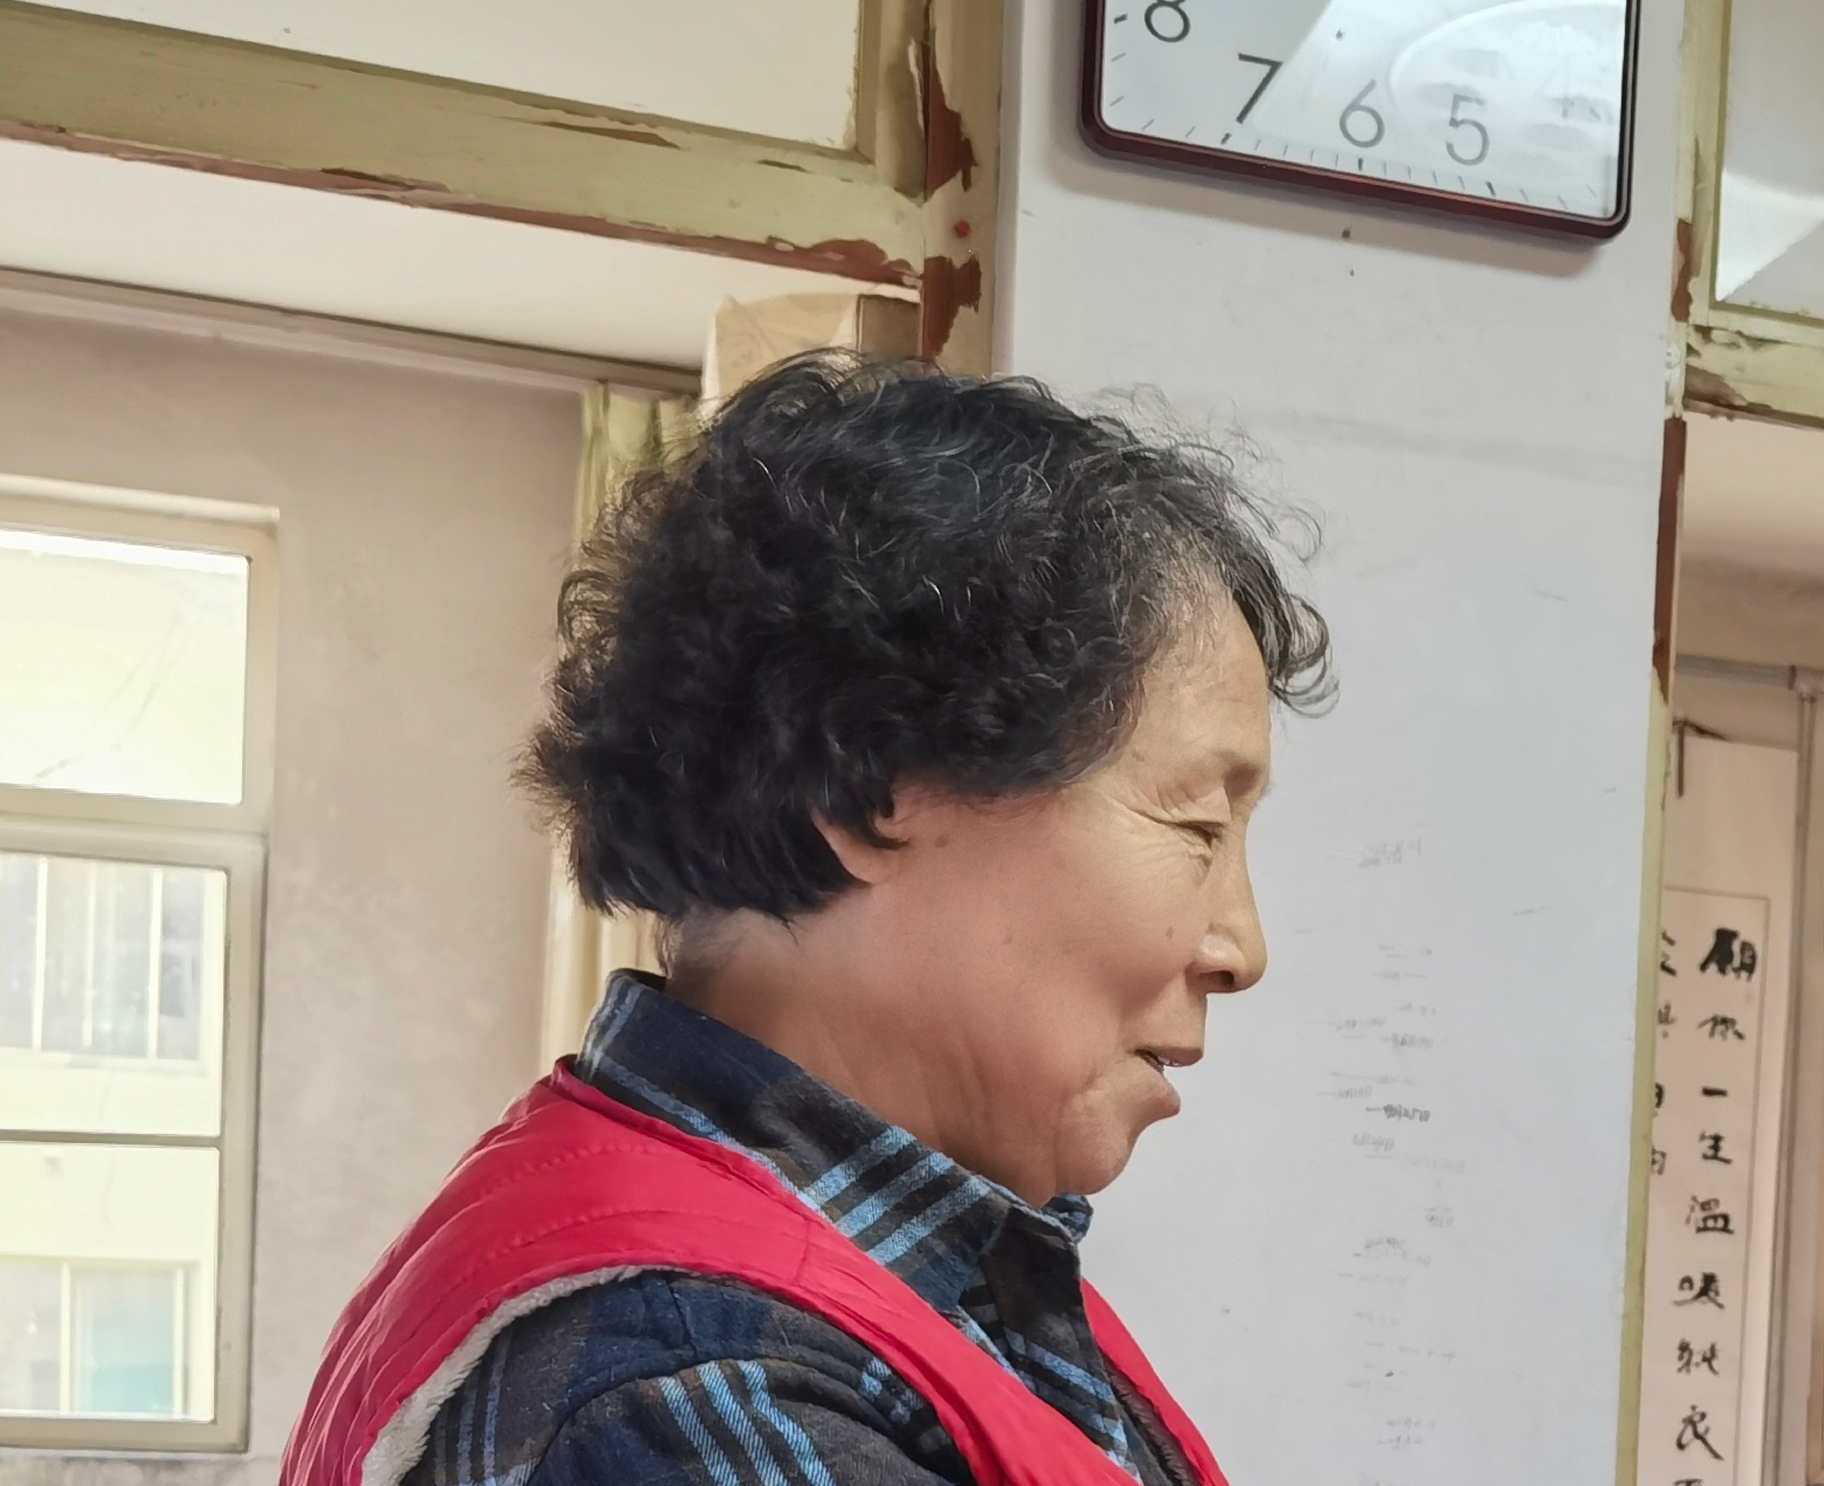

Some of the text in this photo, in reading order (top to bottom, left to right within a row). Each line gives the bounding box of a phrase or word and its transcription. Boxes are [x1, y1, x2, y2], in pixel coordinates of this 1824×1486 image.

[1237, 52, 1283, 124] 7
[1338, 79, 1385, 148] 6
[1445, 93, 1490, 166] 5
